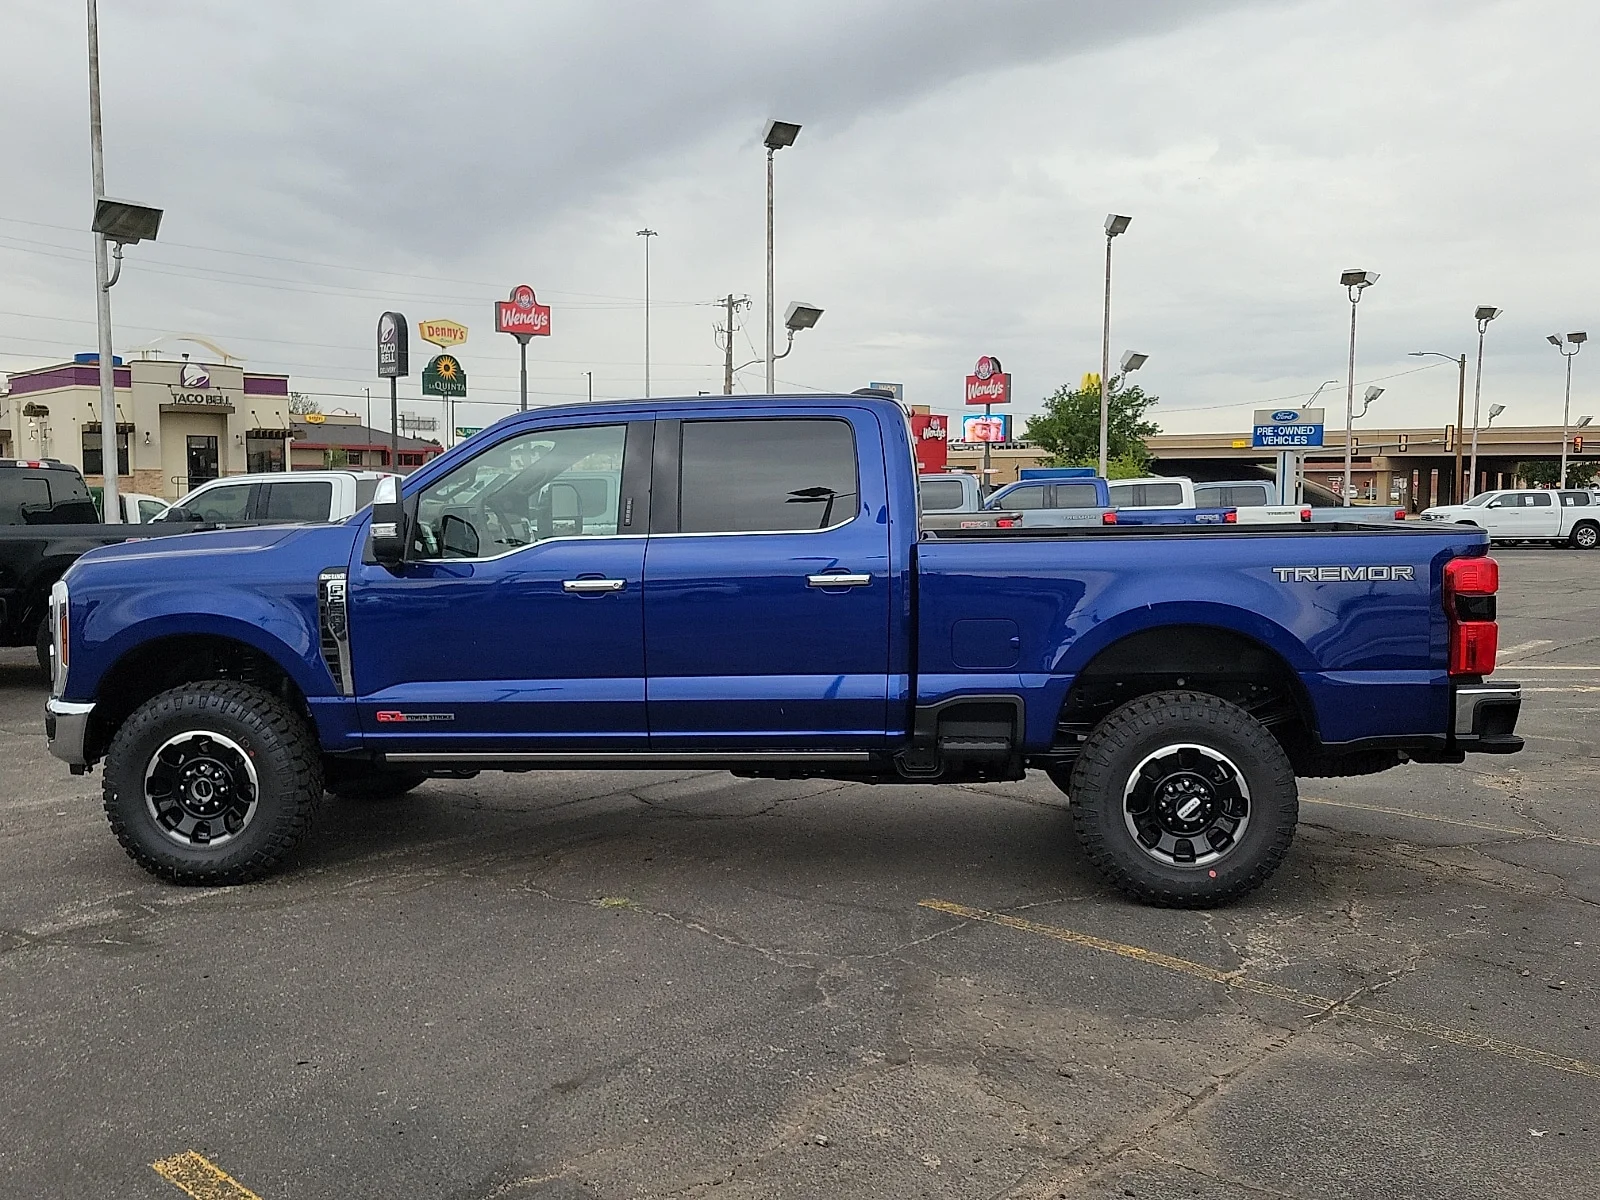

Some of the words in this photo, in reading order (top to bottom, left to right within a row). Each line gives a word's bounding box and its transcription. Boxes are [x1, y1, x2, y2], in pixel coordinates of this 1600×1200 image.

[502, 308, 548, 330] Wendy's
[427, 325, 465, 340] Denny's
[379, 343, 396, 354] TACO
[381, 353, 396, 364] BELL
[435, 381, 466, 392] QUINTA
[967, 379, 1004, 400] Wendy's
[171, 393, 204, 405] TACO
[205, 395, 233, 406] BELL
[1275, 412, 1294, 421] Ford
[923, 426, 946, 440] Wendy's
[1256, 426, 1315, 436] PRE-OWNED
[1262, 436, 1308, 445] VEHICLES
[1272, 565, 1415, 582] TREMOR
